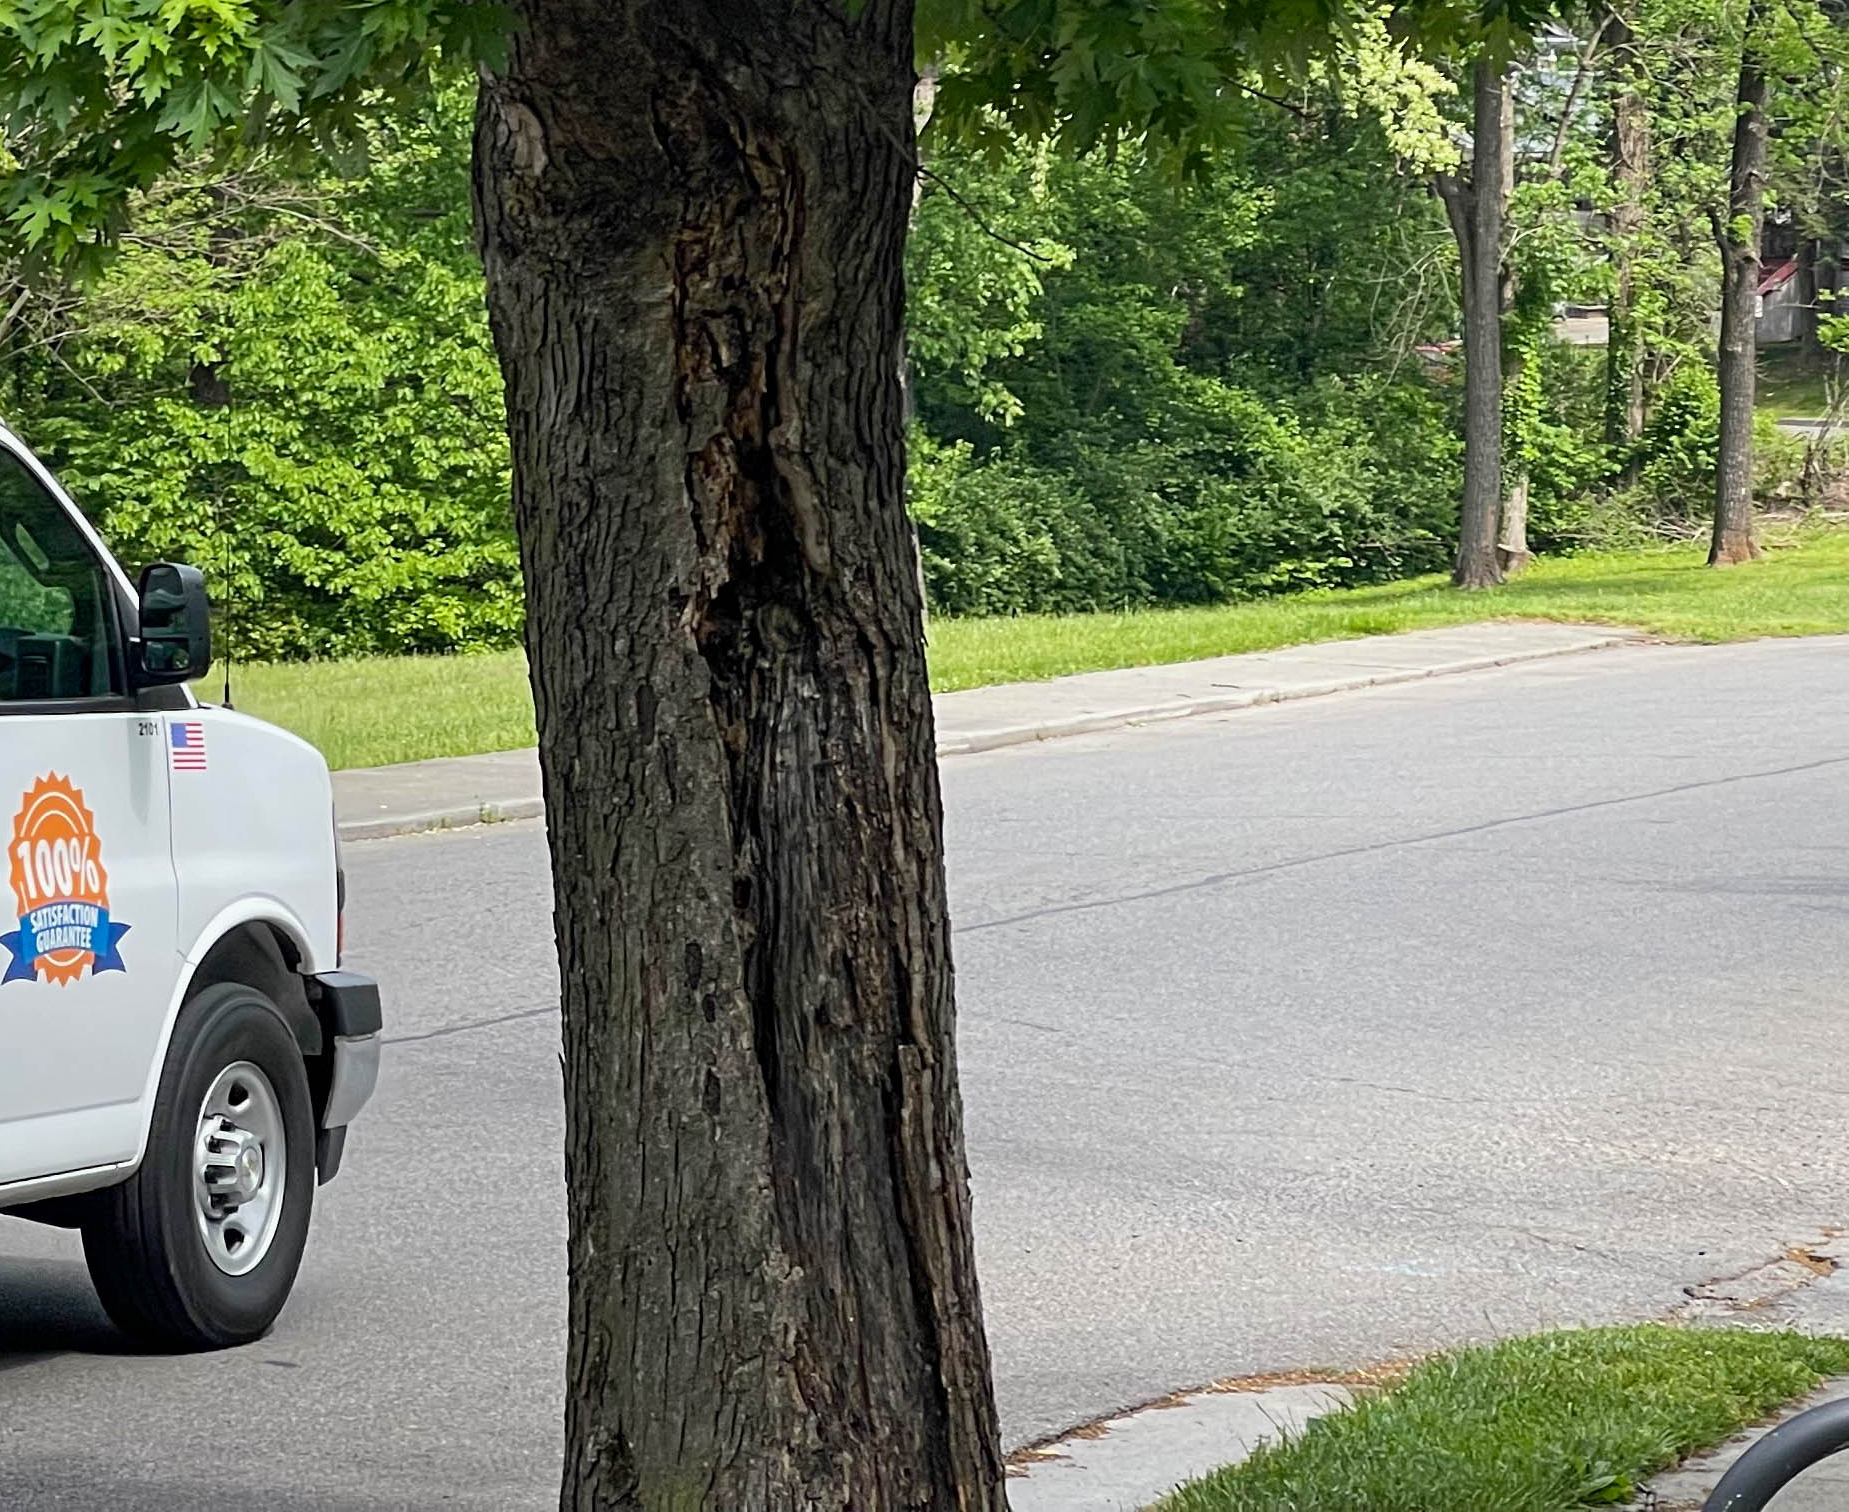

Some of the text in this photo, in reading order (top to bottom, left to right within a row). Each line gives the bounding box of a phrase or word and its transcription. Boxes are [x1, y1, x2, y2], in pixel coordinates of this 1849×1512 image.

[138, 721, 159, 736] 2101
[17, 836, 100, 899] 100%
[30, 903, 99, 934] SATISFACTION
[35, 925, 92, 953] GUARANTEE
